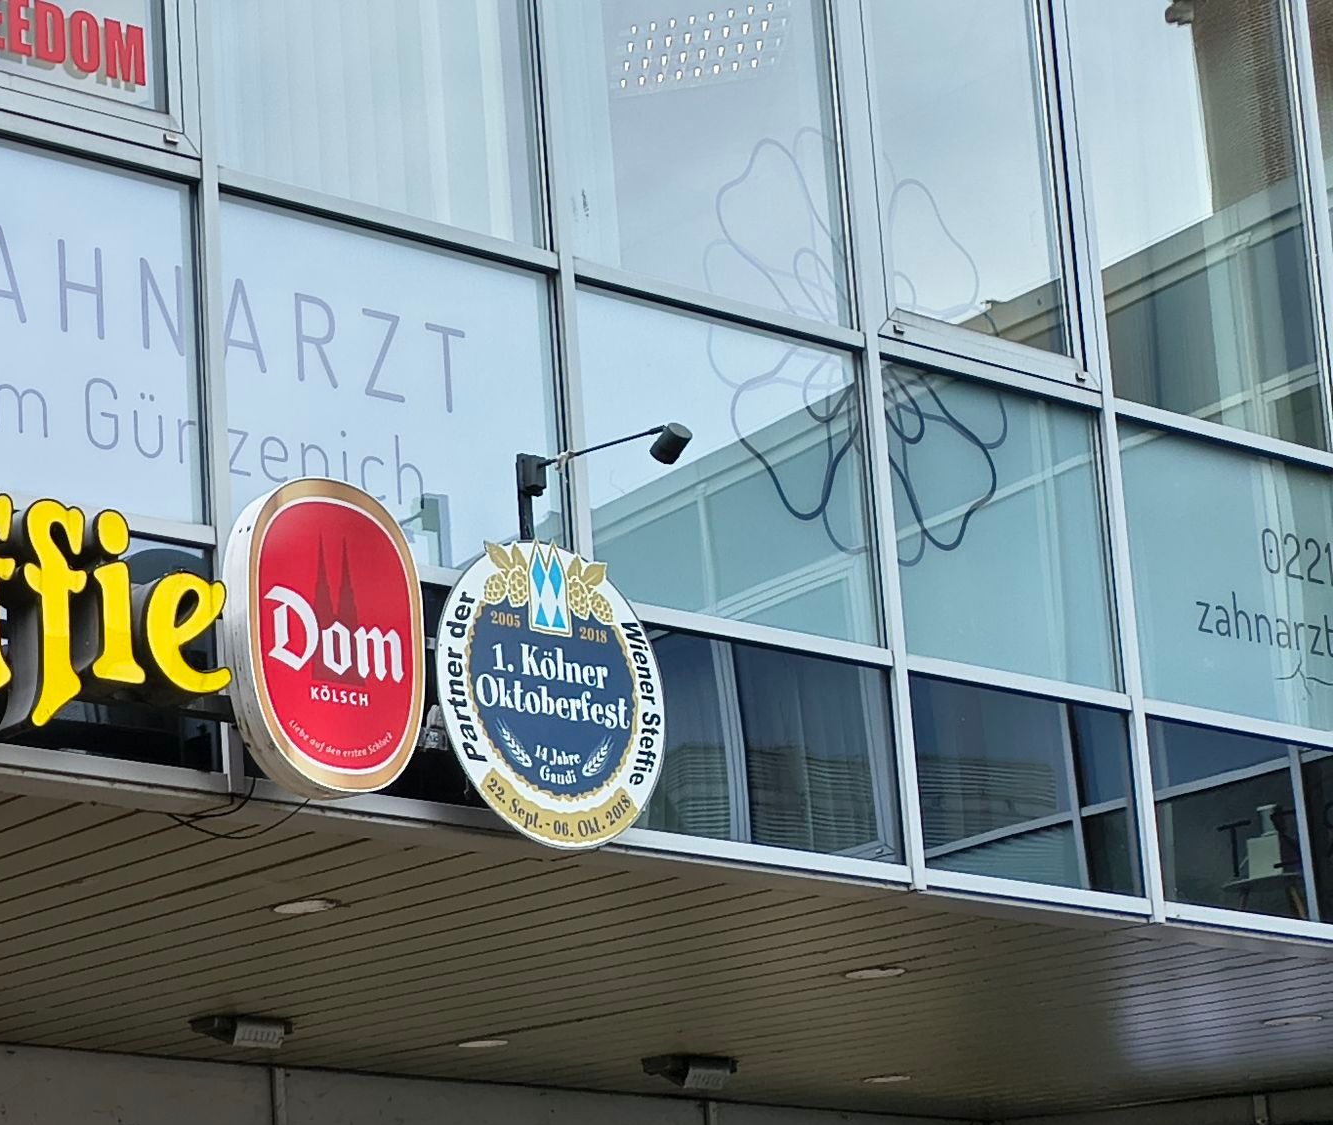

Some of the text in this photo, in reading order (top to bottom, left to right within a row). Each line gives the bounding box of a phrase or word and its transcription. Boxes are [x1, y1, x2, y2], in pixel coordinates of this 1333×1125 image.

[264, 585, 404, 684] Dom
[490, 610, 521, 628] 2005
[579, 626, 608, 644] 2018
[446, 591, 488, 763] Partner der
[492, 642, 609, 690] 1. Kölner
[310, 684, 369, 707] KÖLSCH
[476, 673, 631, 729] Oktoberfest
[621, 621, 661, 786] Wiener Steffie
[539, 765, 577, 785] Gaudi
[547, 747, 582, 766] Jahre
[487, 777, 506, 804] 22.
[553, 820, 574, 837] 06.
[577, 815, 606, 838] Okt.
[605, 794, 632, 826] 2018
